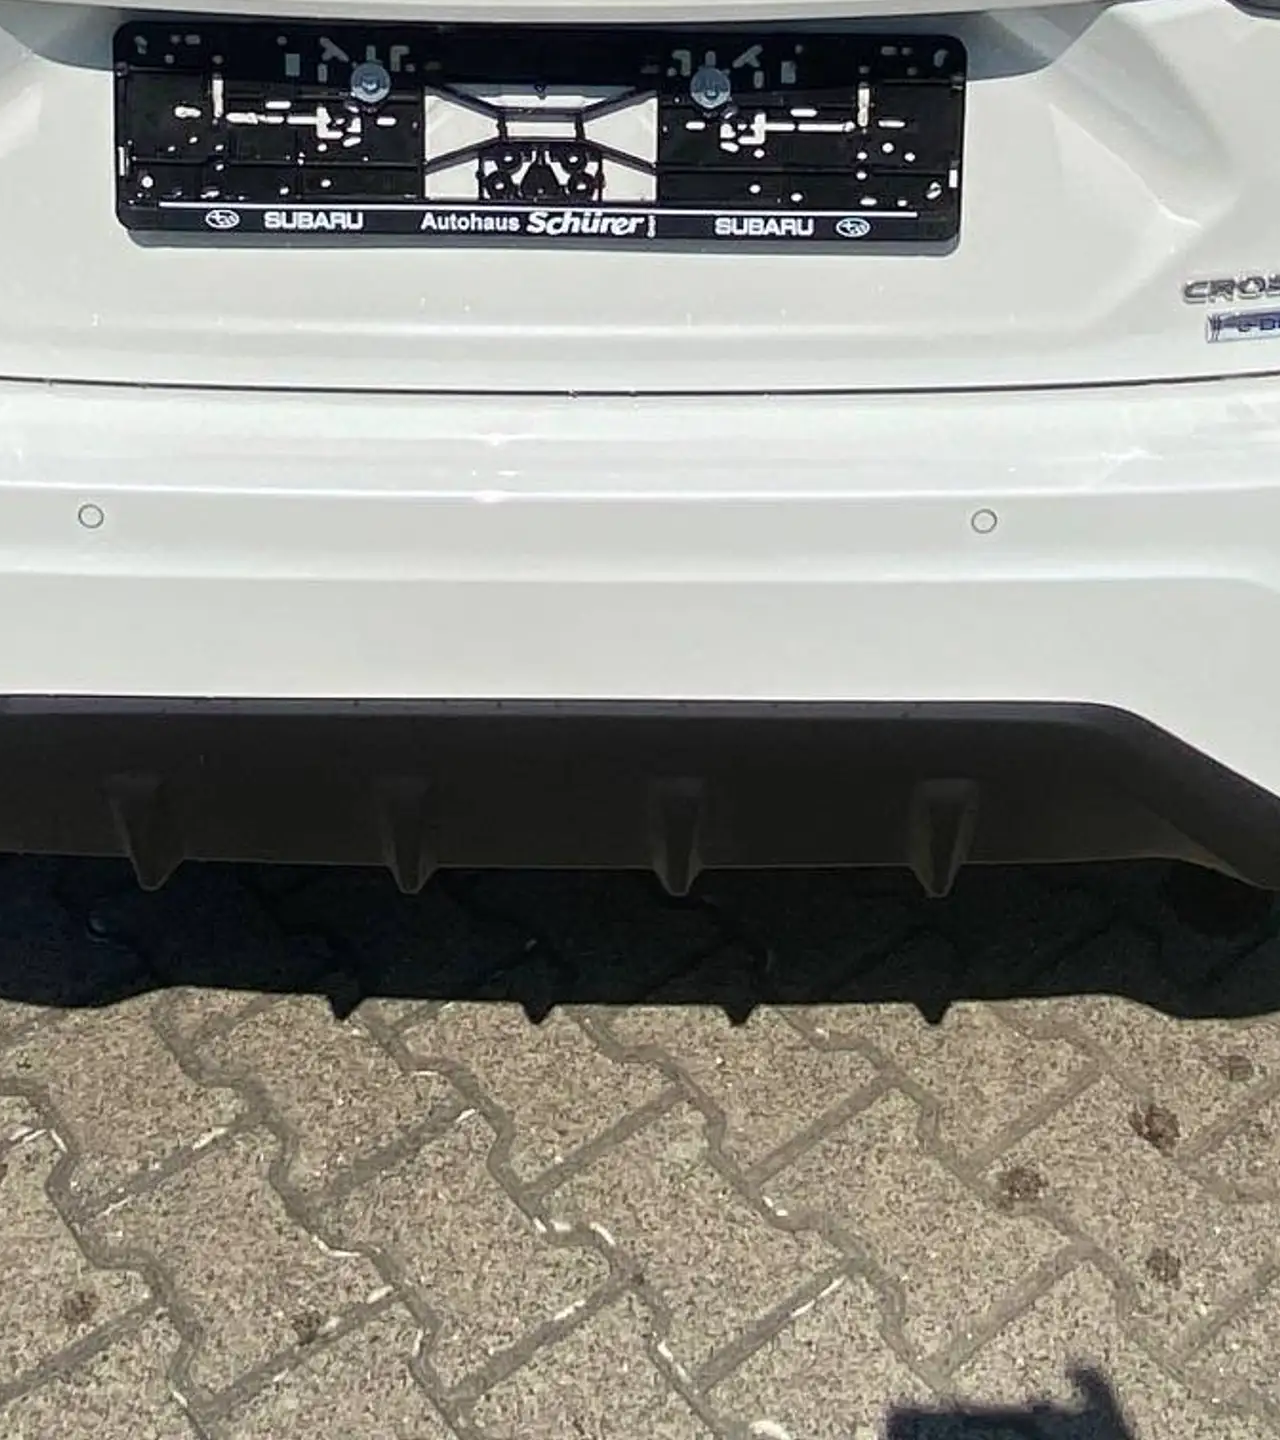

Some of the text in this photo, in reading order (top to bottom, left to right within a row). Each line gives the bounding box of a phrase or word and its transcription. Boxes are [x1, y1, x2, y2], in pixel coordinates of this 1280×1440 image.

[263, 211, 364, 230] SUBARU
[420, 211, 521, 232] Autohaus
[525, 209, 645, 236] Schürer
[714, 216, 815, 237] SUBARU
